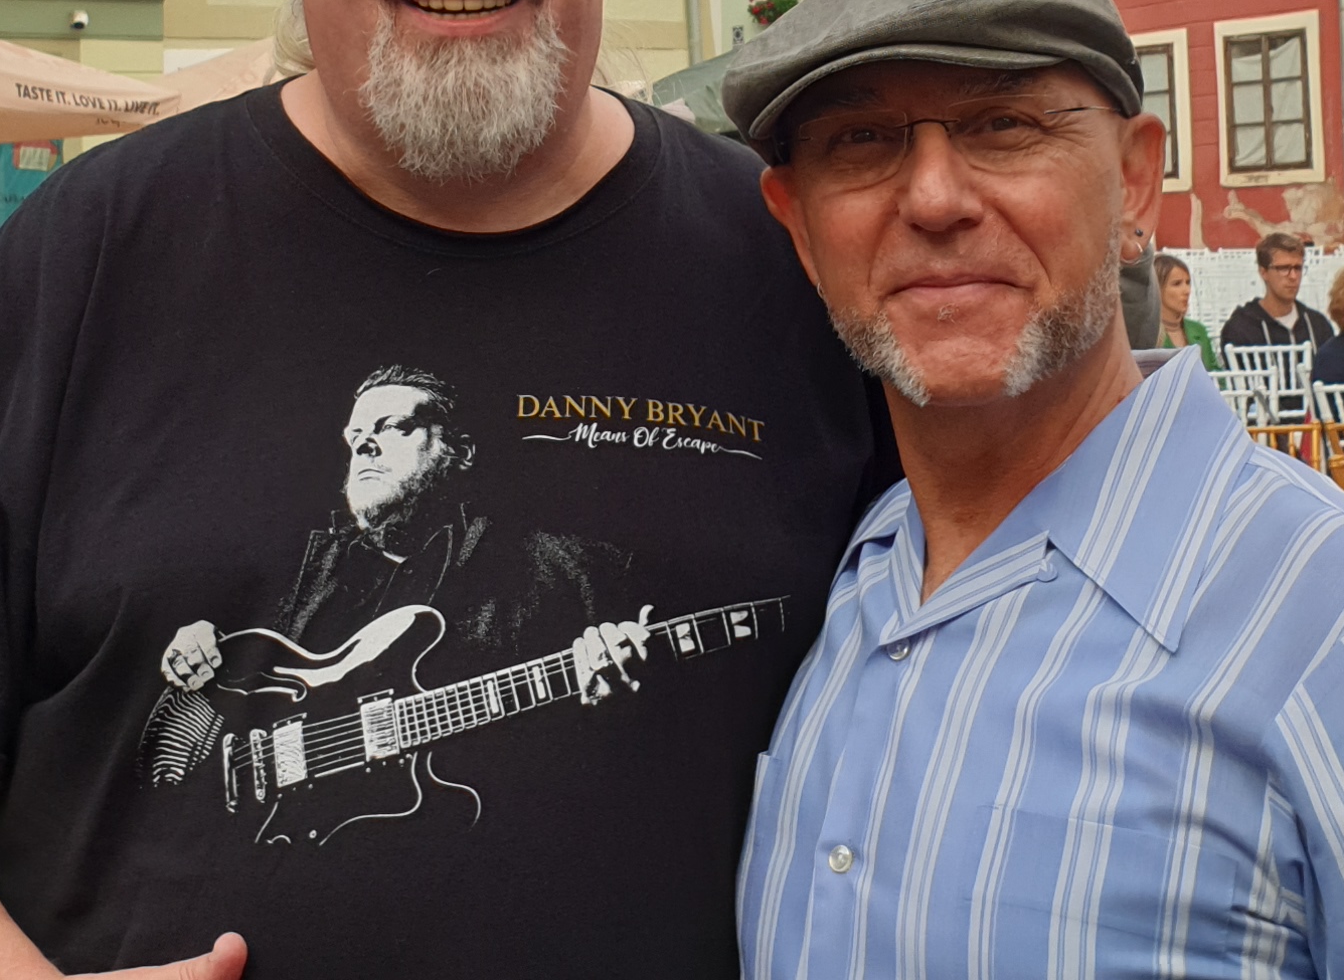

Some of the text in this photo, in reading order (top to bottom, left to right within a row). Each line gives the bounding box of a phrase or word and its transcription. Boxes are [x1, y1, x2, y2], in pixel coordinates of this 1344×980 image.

[15, 83, 54, 102] TASTE
[55, 90, 71, 105] IT.
[72, 93, 105, 110] LOVE
[517, 394, 765, 442] DANNY BRYANT
[561, 422, 729, 454] Means Of Escape
